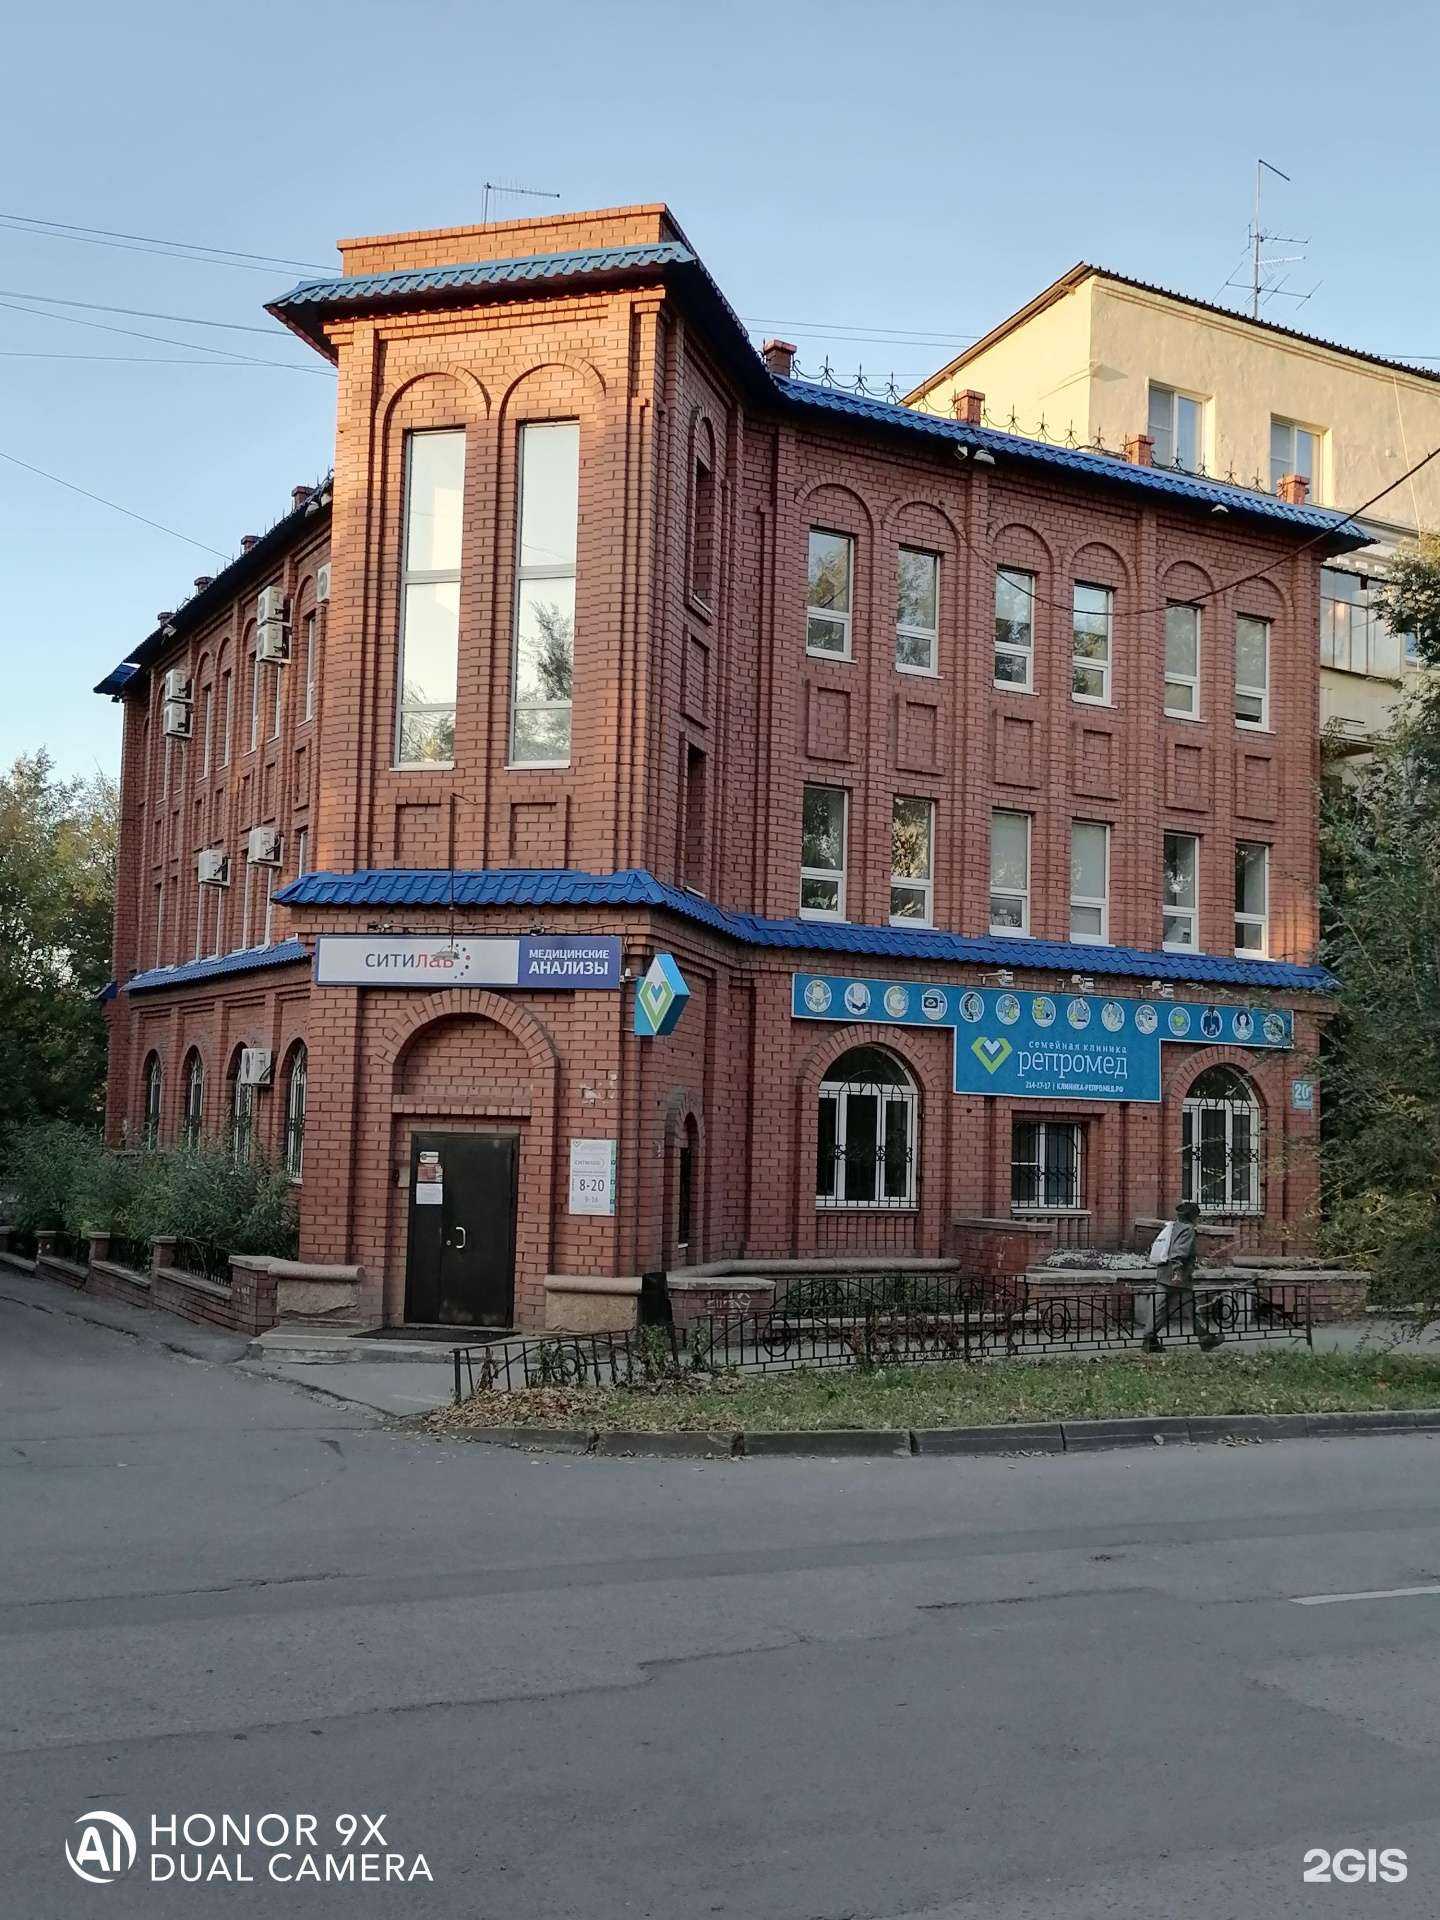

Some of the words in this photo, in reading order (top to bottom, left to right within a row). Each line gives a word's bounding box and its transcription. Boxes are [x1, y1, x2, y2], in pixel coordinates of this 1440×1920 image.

[529, 949, 610, 960] МЕДИЦИНСКИЕ
[528, 961, 609, 975] АНАЛИЗЫ
[1017, 1051, 1129, 1079] репромед
[579, 1178, 605, 1192] 8-20
